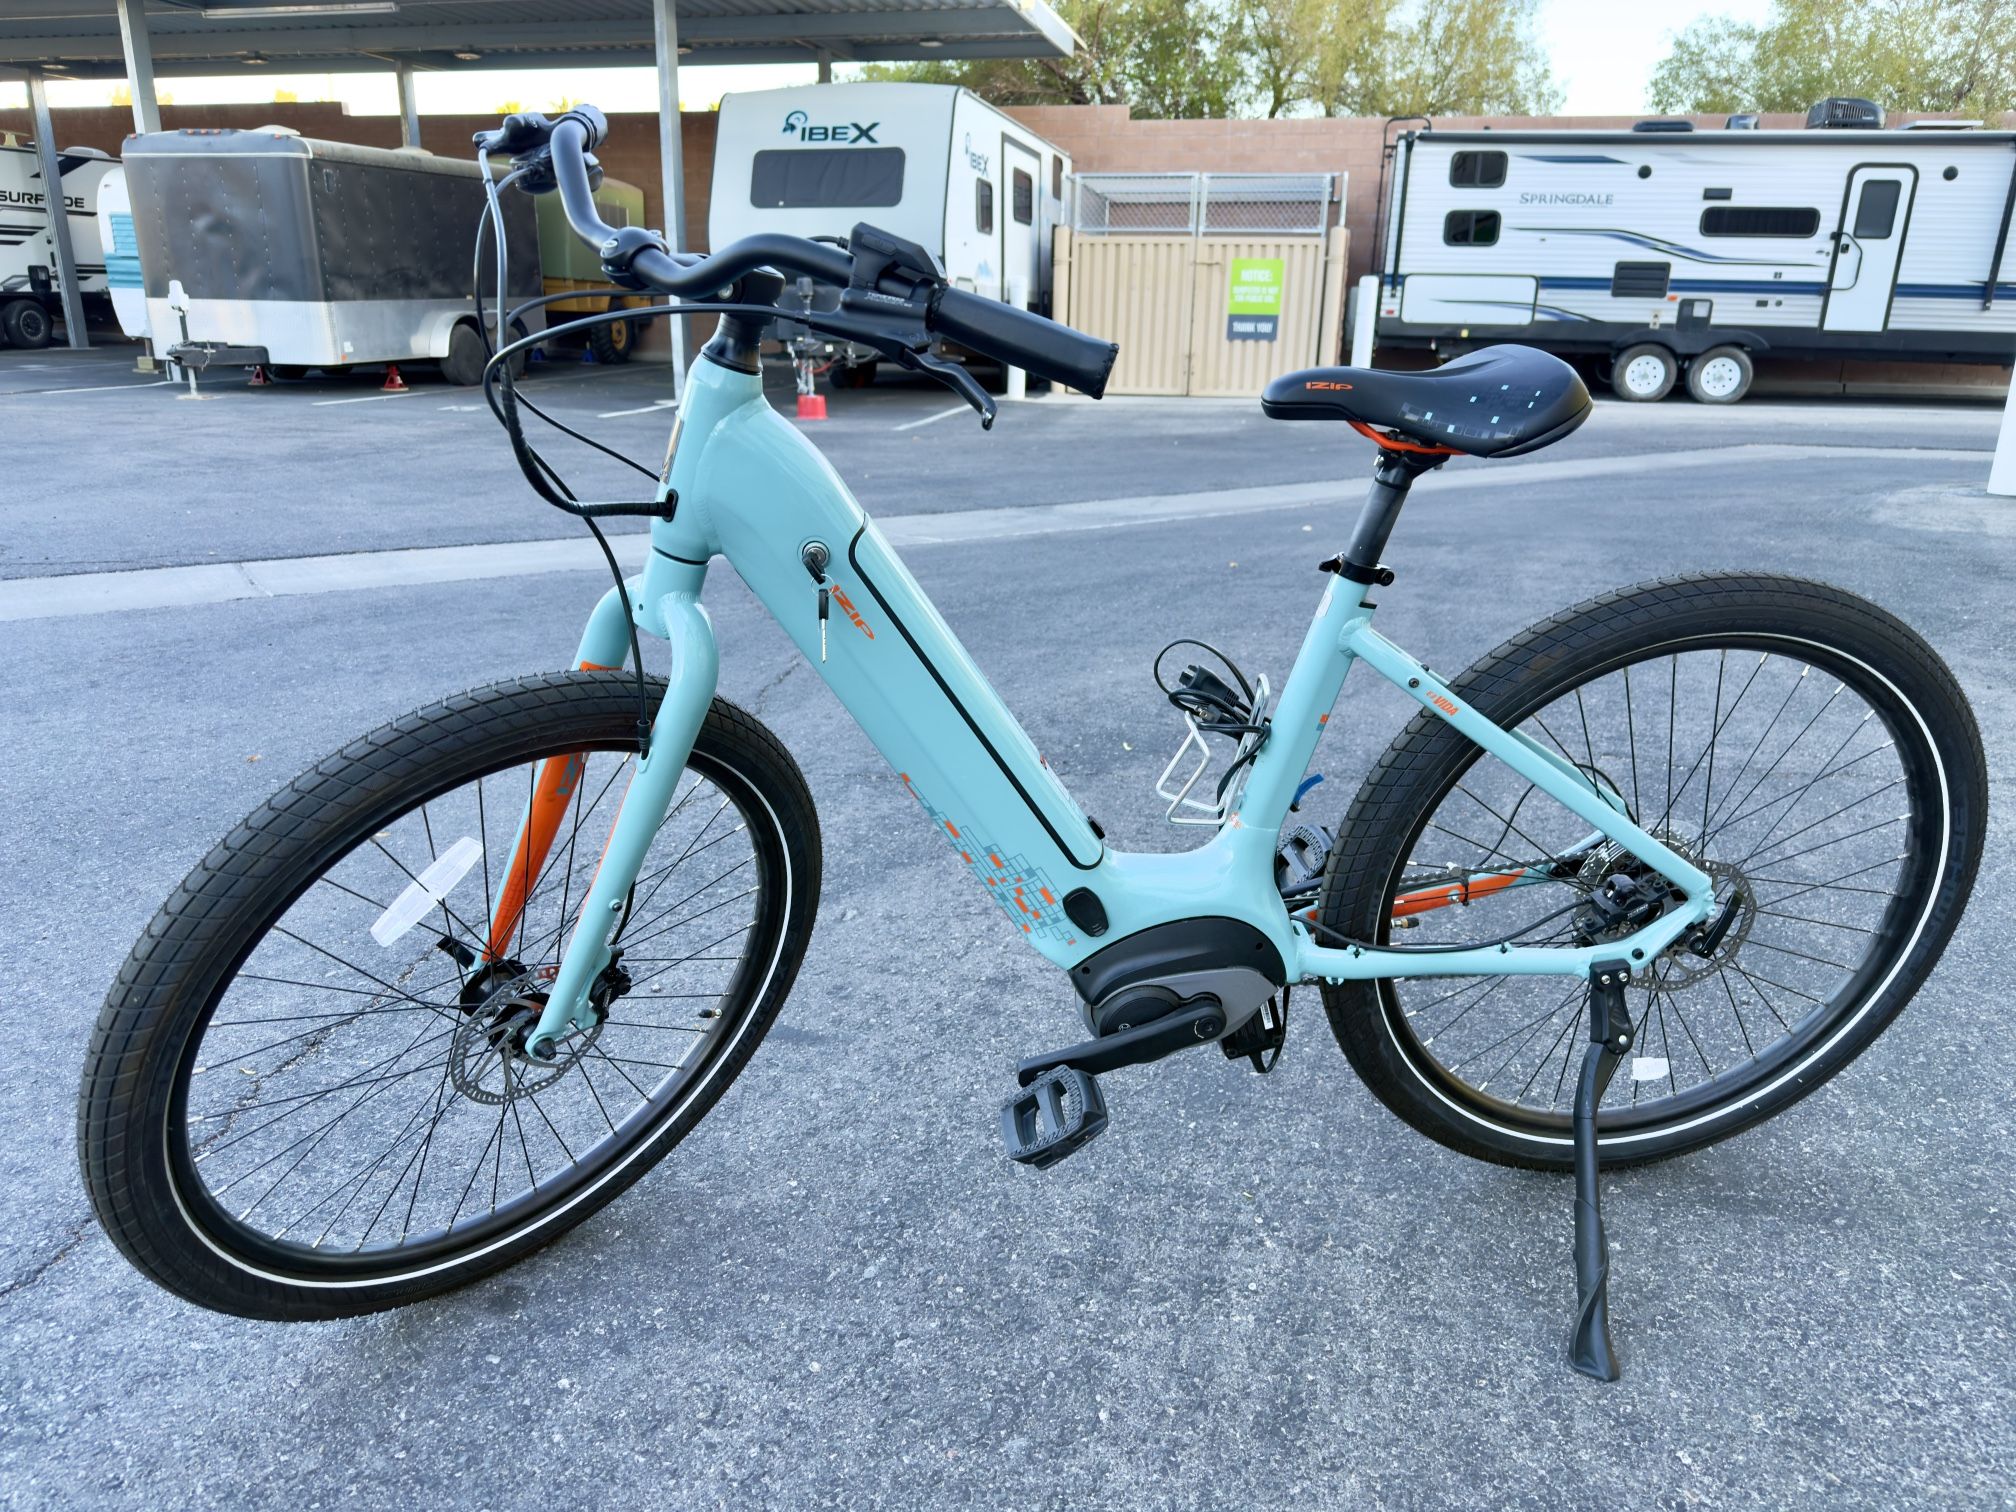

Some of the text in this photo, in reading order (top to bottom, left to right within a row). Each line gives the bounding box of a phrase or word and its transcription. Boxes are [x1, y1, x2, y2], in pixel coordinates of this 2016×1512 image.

[801, 122, 880, 144] IBEX
[0, 190, 85, 208] SURFDE
[1519, 192, 1614, 205] SPRINGDALE
[1433, 696, 1458, 715] VIDA
